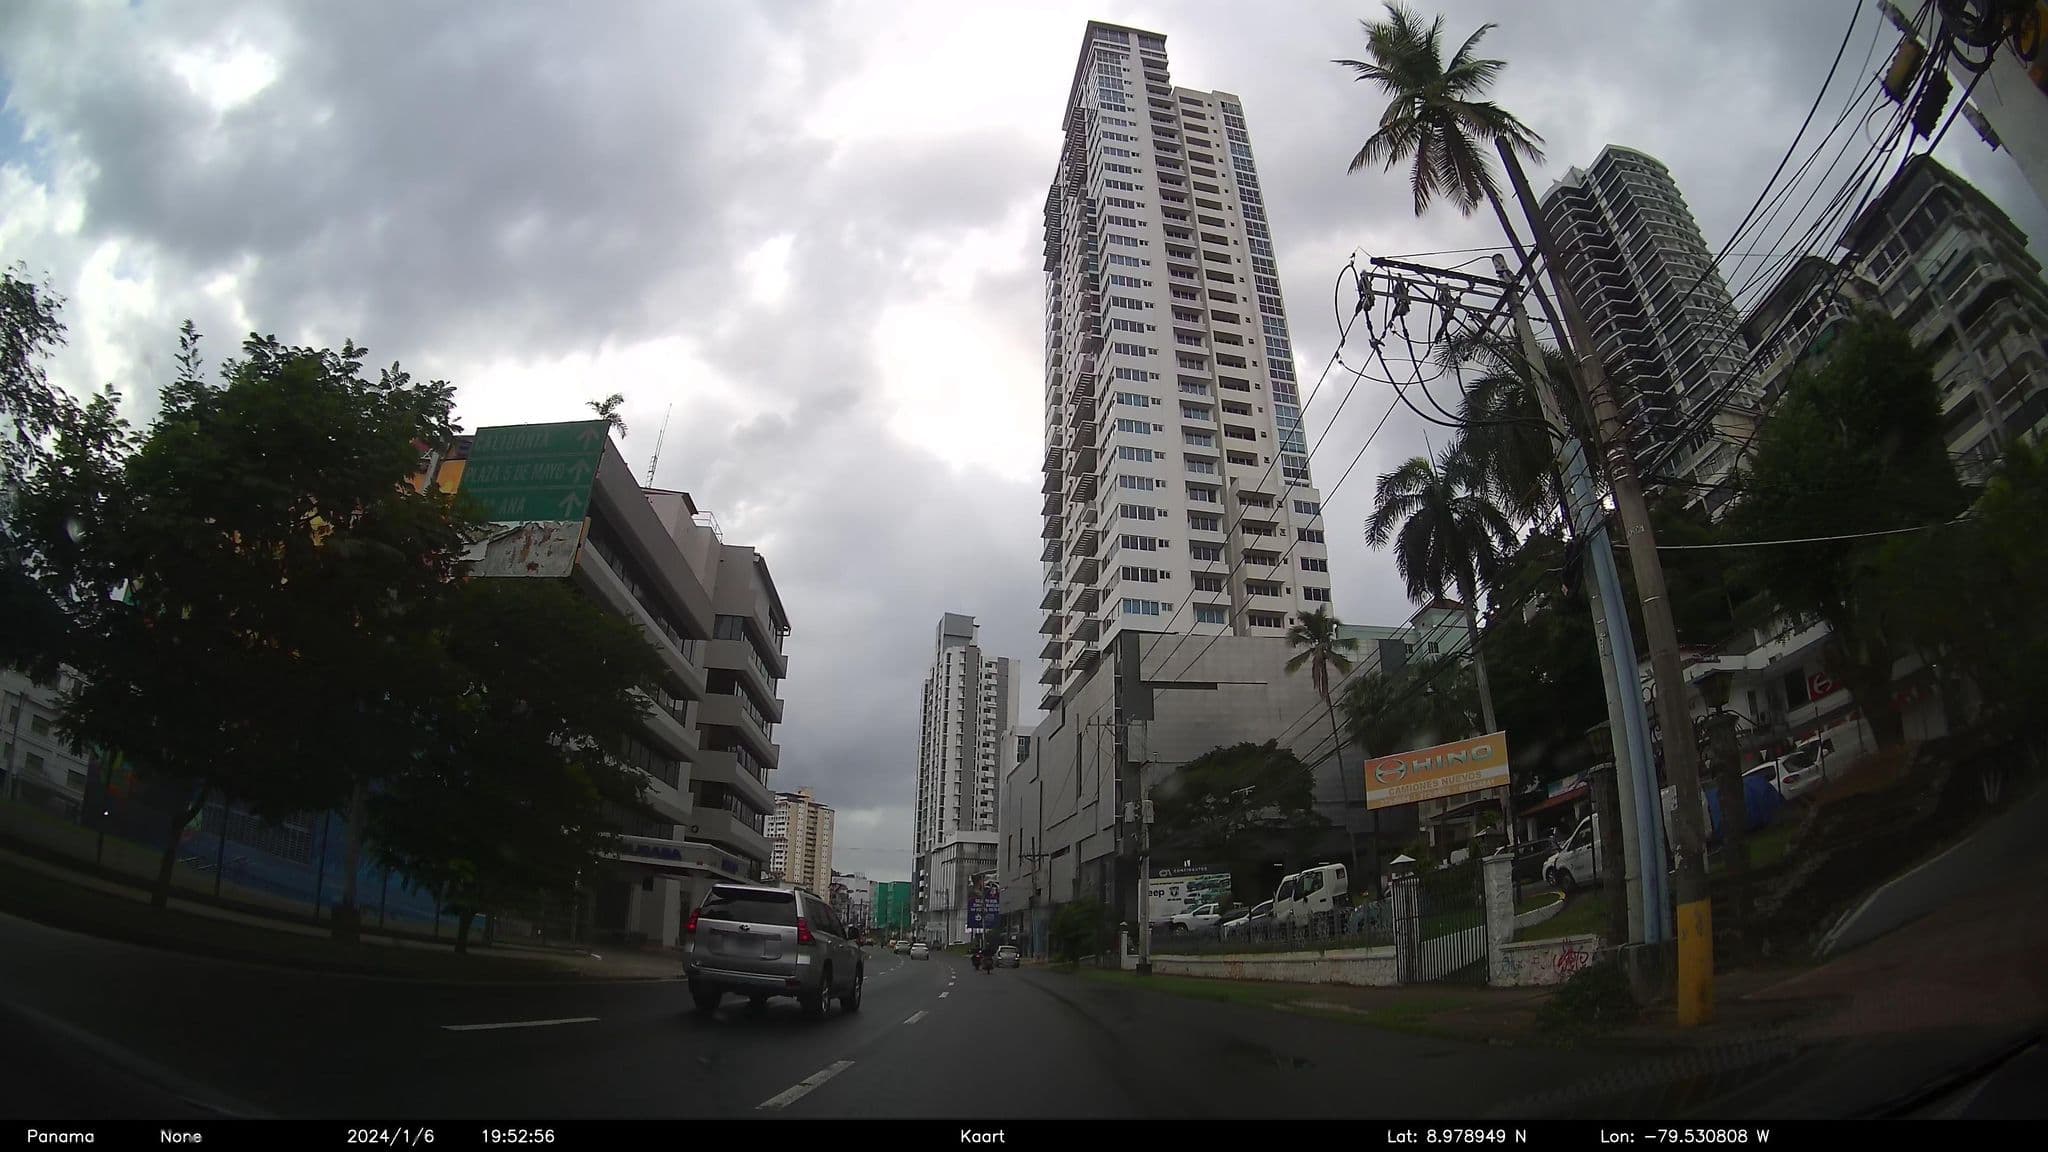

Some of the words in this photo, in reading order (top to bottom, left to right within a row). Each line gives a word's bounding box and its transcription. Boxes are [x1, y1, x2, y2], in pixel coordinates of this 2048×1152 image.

[467, 465, 499, 482] PLAZA
[502, 464, 513, 482] 5
[513, 463, 529, 481] DE
[531, 463, 565, 480] MAYO
[1412, 744, 1492, 773] HINO
[1388, 779, 1438, 797] CAMIONES
[1441, 771, 1482, 787] NUEVOS
